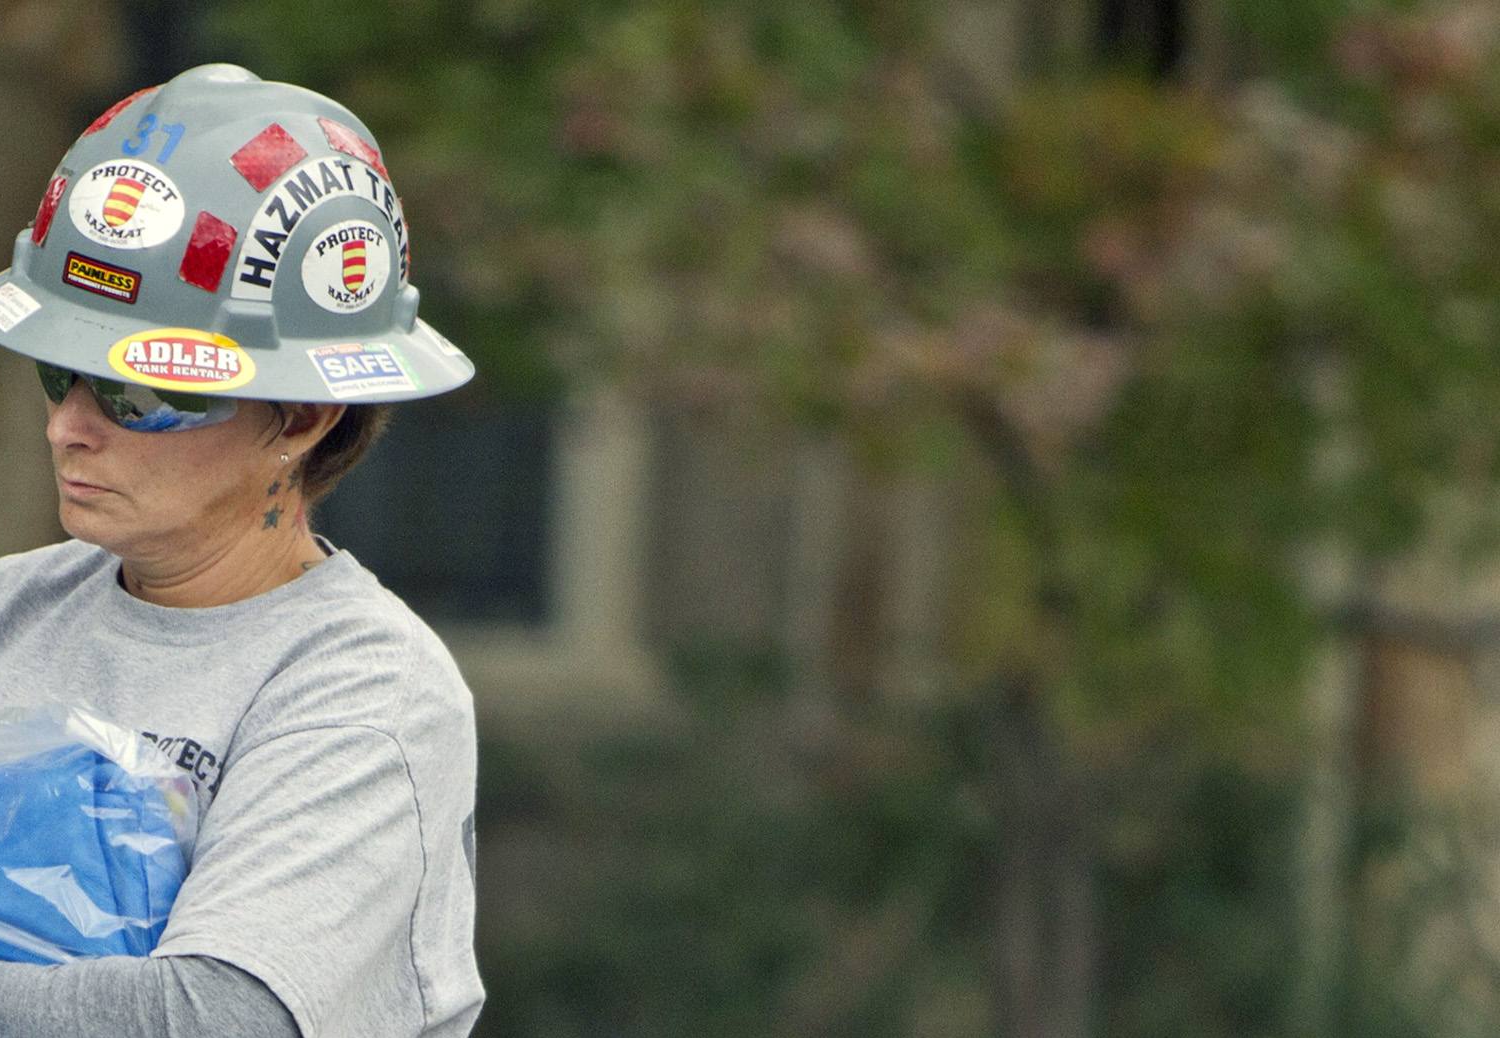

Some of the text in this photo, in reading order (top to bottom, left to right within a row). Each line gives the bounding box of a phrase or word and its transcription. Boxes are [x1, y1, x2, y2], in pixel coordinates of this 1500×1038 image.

[122, 112, 186, 164] 31
[90, 164, 178, 202] PROTECT
[84, 208, 146, 239] HAZ-MAT
[239, 159, 408, 289] HAZMAT TEAM
[315, 226, 384, 257] PROTECT
[70, 261, 134, 290] PAINLESS
[328, 280, 376, 304] HAZ-MAT
[124, 341, 240, 373] ADLER
[133, 363, 232, 381] TANK RENTALS
[322, 353, 399, 379] SAFE
